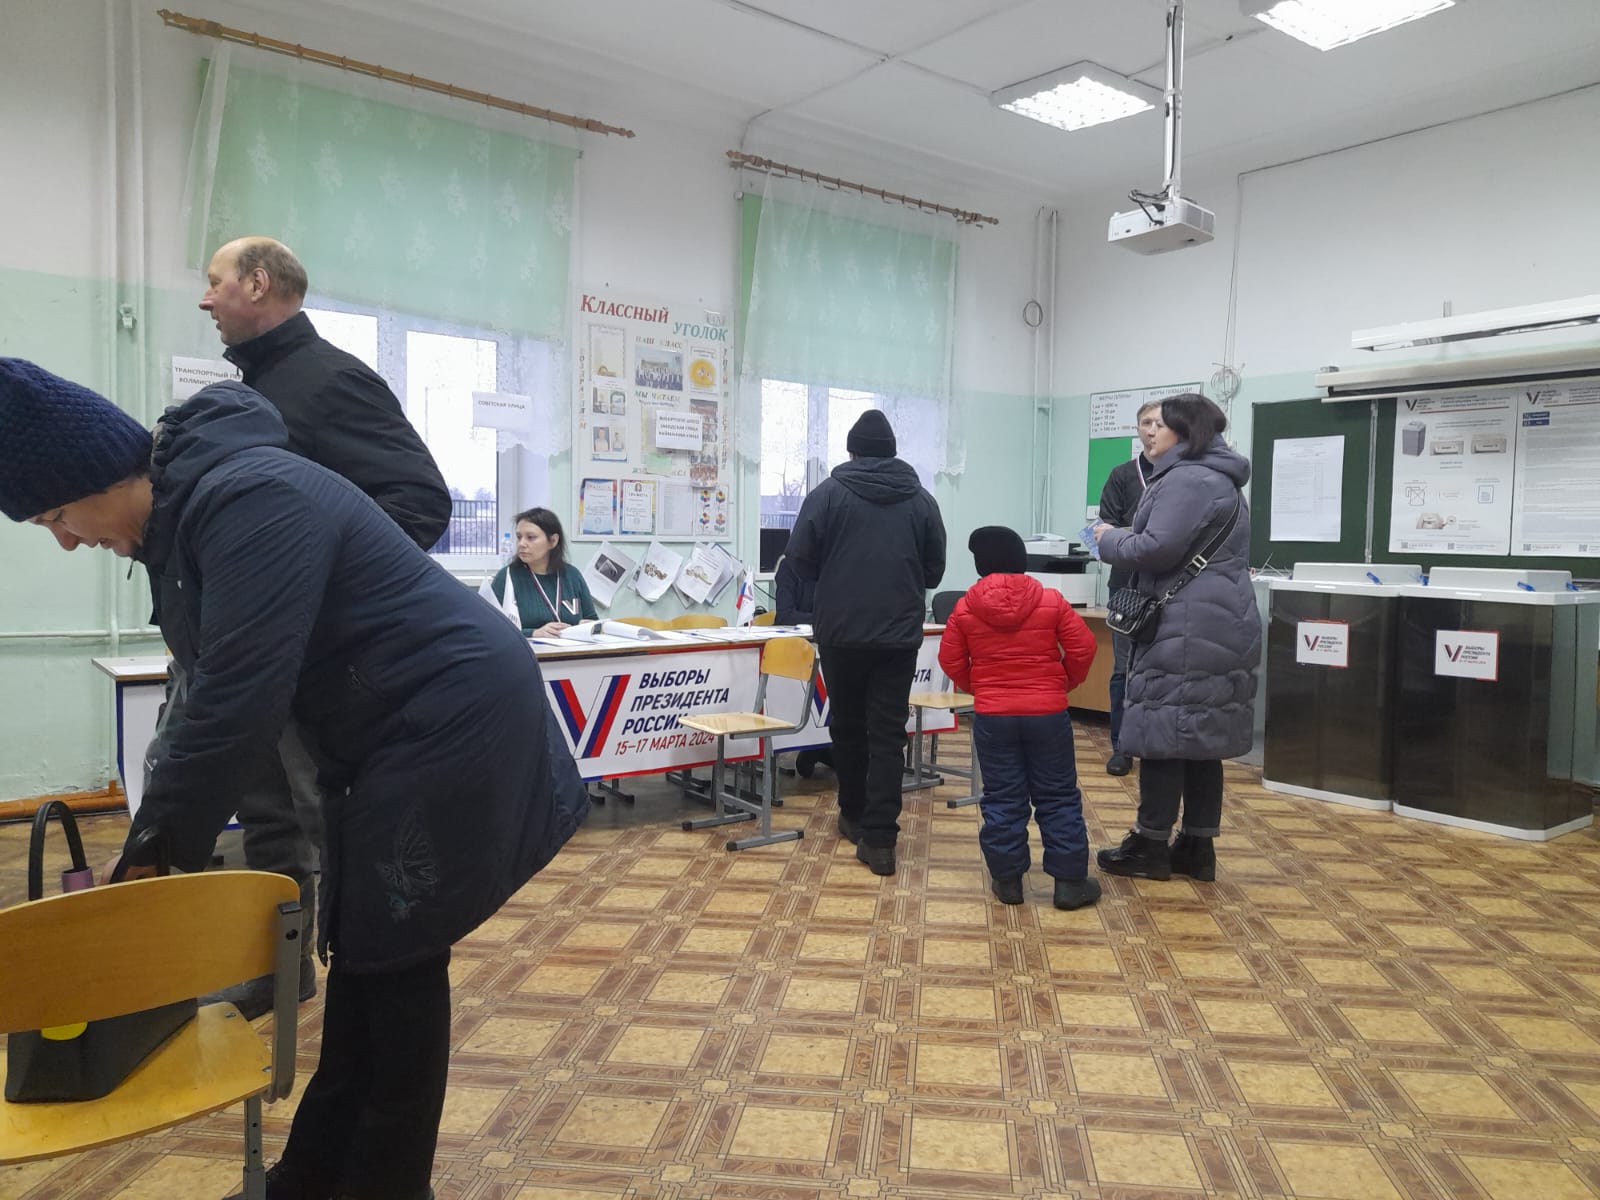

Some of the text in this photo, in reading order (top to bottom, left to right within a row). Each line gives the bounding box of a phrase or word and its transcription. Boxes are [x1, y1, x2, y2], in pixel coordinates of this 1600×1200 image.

[580, 294, 669, 324] КЛАССНЫЙ
[672, 320, 728, 342] УГОЛОК
[639, 668, 711, 689] ВЫБОРЫ
[630, 687, 730, 712] ПРЕЗИДЕНТА
[649, 733, 688, 752] МАРТА
